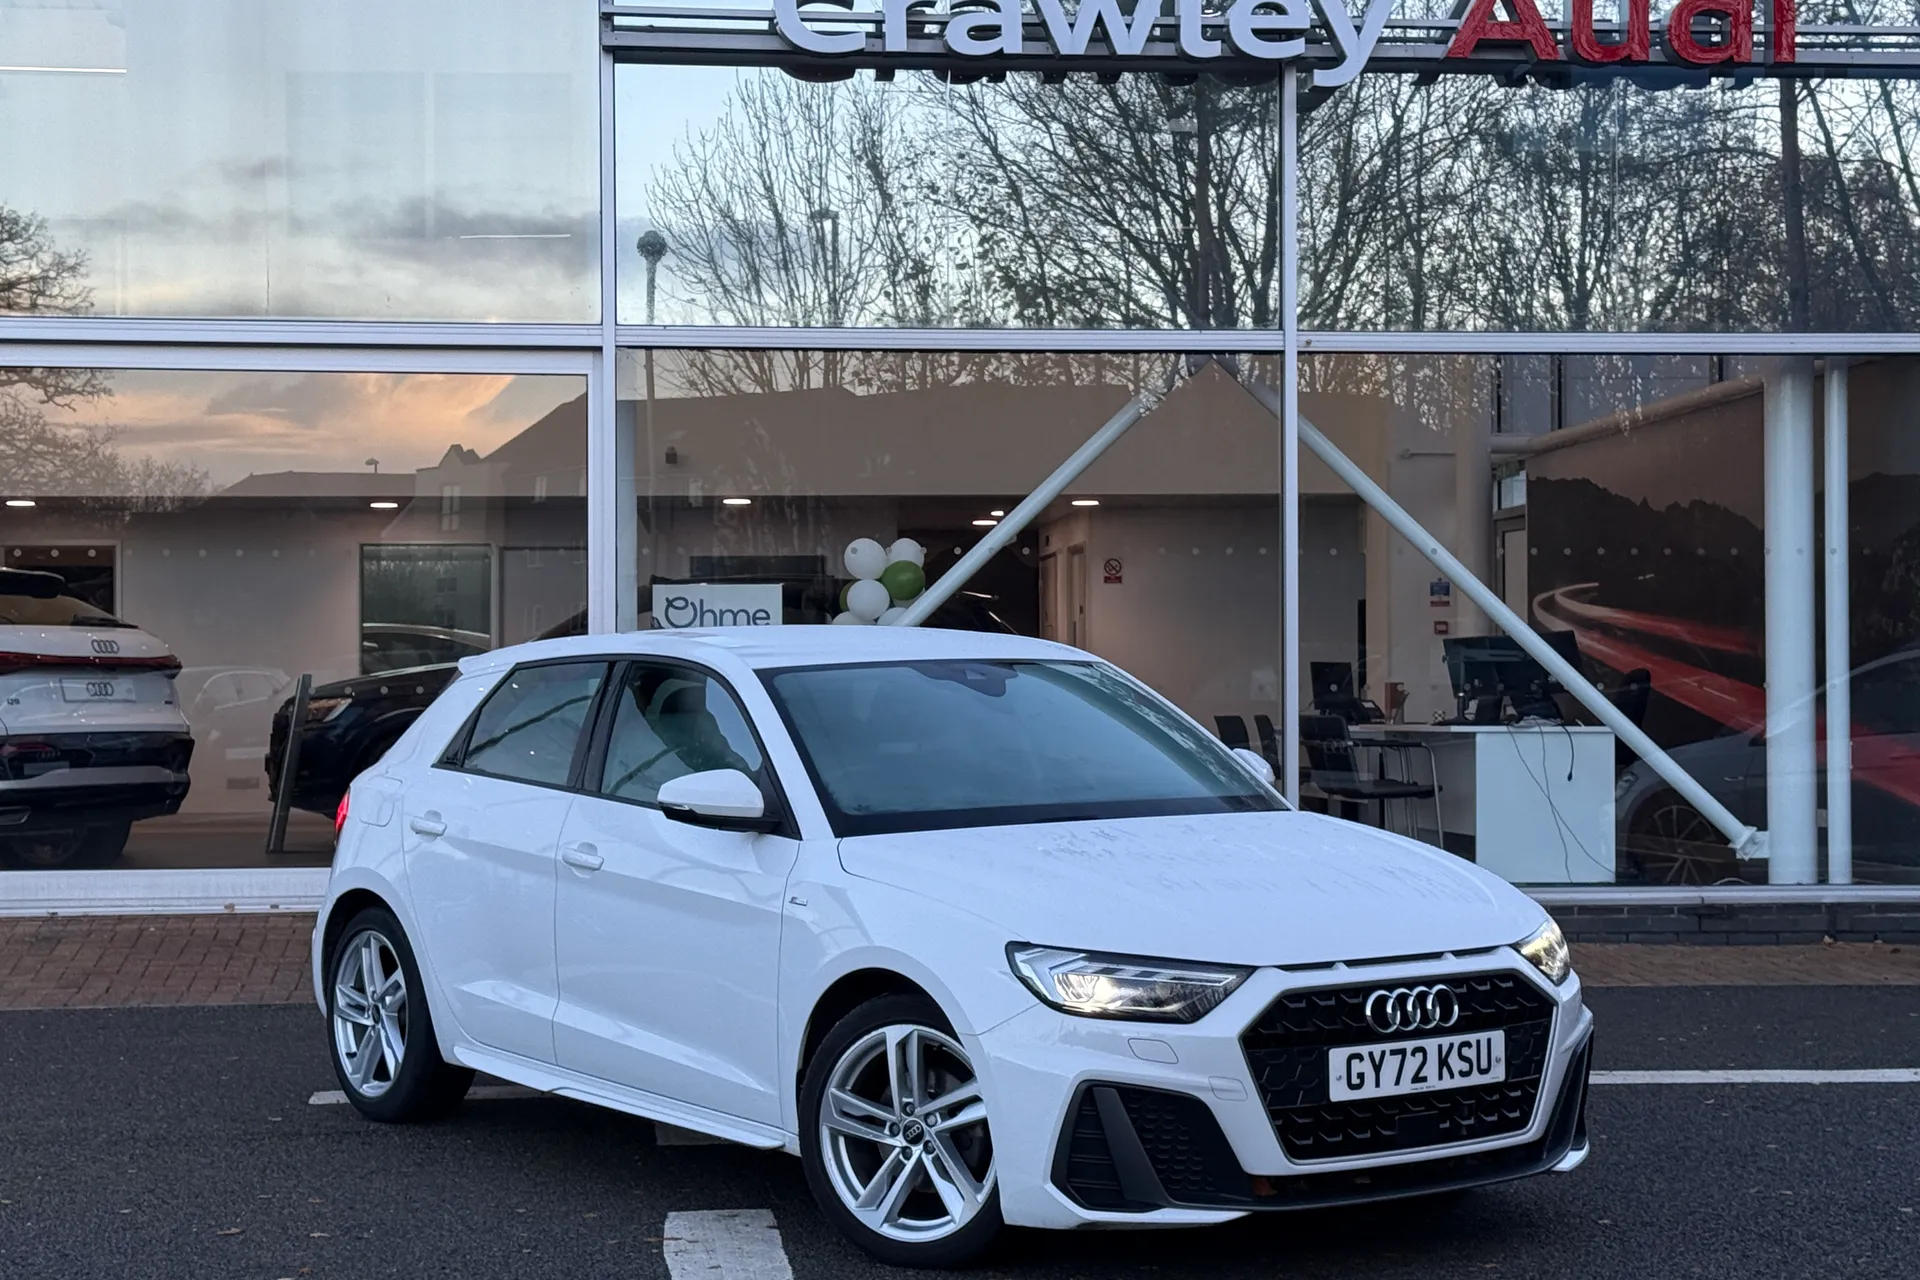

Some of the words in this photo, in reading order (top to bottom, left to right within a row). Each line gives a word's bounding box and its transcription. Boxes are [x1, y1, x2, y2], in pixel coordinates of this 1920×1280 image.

[664, 596, 771, 628] Ohme
[1346, 1046, 1428, 1090] GY72
[1437, 1037, 1492, 1081] KSU
